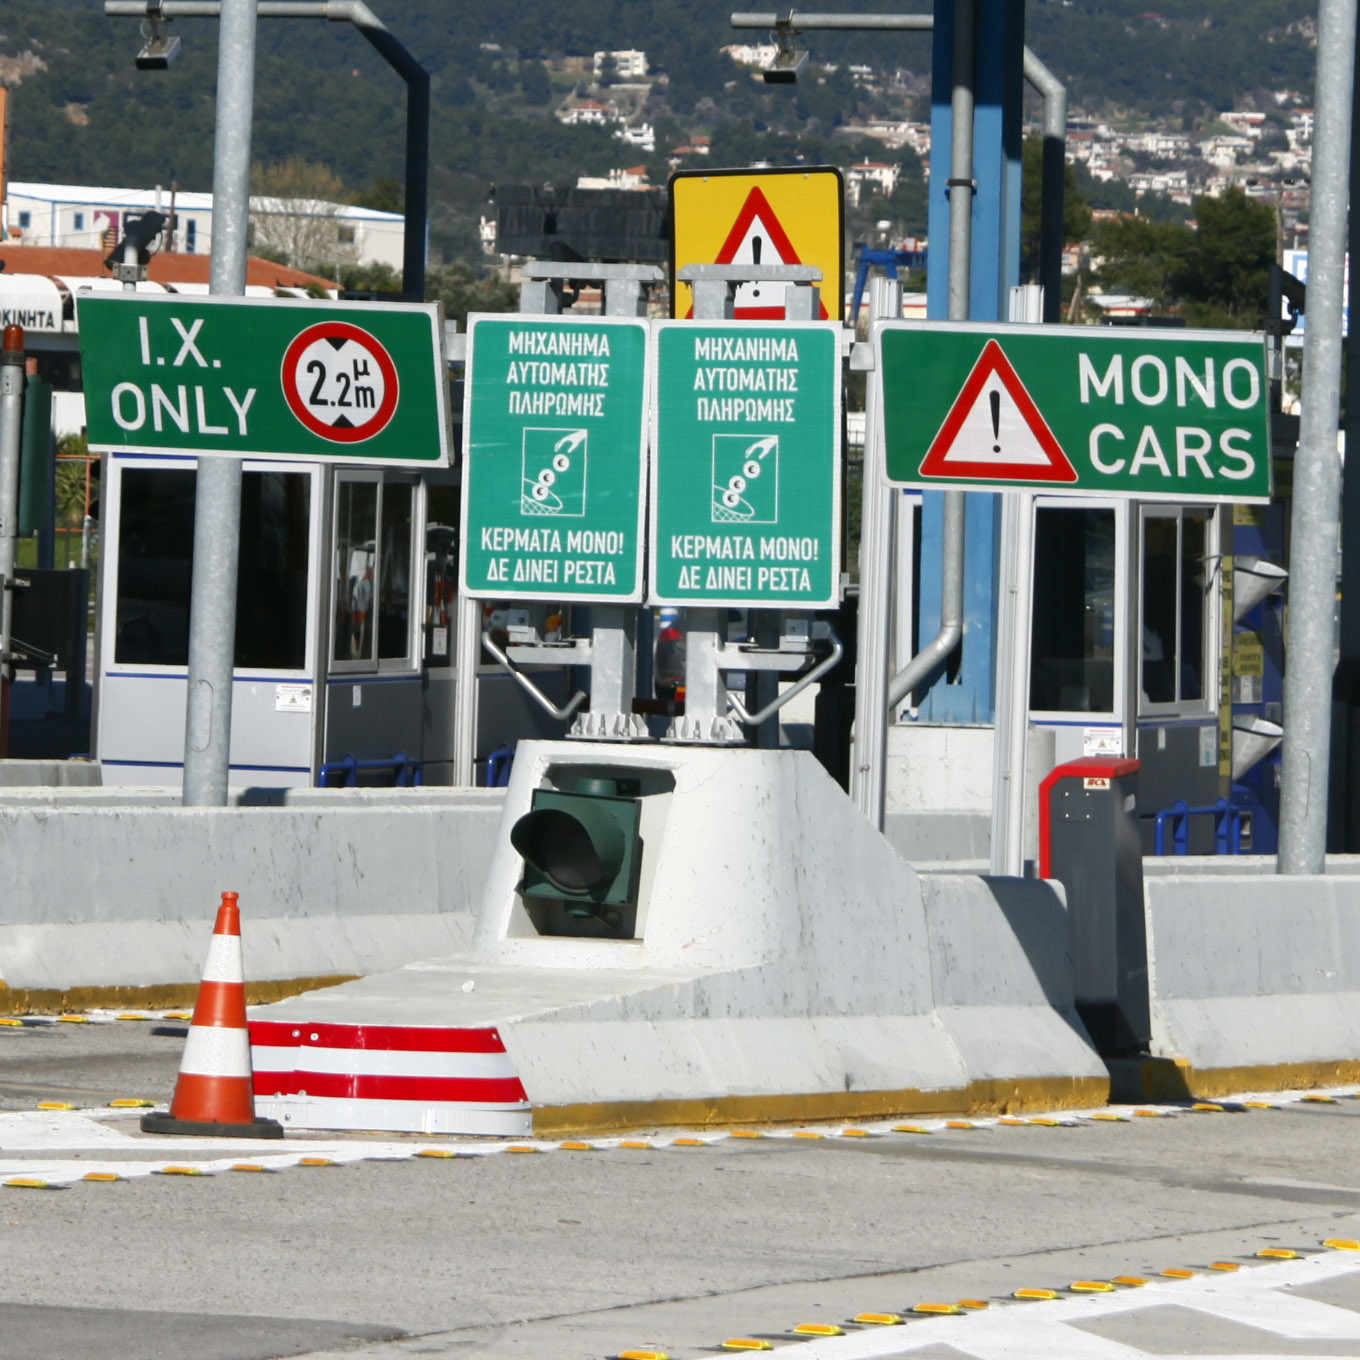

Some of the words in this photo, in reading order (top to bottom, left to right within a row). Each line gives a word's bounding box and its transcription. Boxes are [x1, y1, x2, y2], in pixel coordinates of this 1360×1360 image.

[509, 331, 610, 356] ΜΗΧΑΝΗΜΑ
[694, 338, 799, 361] ΜΗΧΑΝΗΜΑ
[506, 362, 609, 386] ΑΥΤΟΜΑΤΗΣ
[693, 368, 799, 391] ΑΥΤΟΜΑΤΗΣ
[111, 382, 256, 435] ONLY
[509, 392, 605, 416] ΠΛΗΡΩΜΗΣ
[697, 398, 796, 422] ΠΛΗΡΩΜΗΣ
[1089, 423, 1255, 480] CARS
[481, 528, 562, 552] ΚΕΡΜΑΤΑ
[566, 530, 624, 554] ΜΟΝΟ!
[671, 536, 755, 559] ΚΕΡΜΑΤΑ
[759, 537, 819, 560] ΜΟΝΟ!
[486, 558, 509, 581] ΔΕ
[513, 559, 558, 582] ΔΙΝΕΙ
[563, 561, 616, 585] ΡΕΣΤΑ
[678, 566, 701, 589] ΔΕ
[705, 567, 752, 590] ΔΙΝΕΙ
[757, 568, 812, 591] ΡΕΣΤΑ
